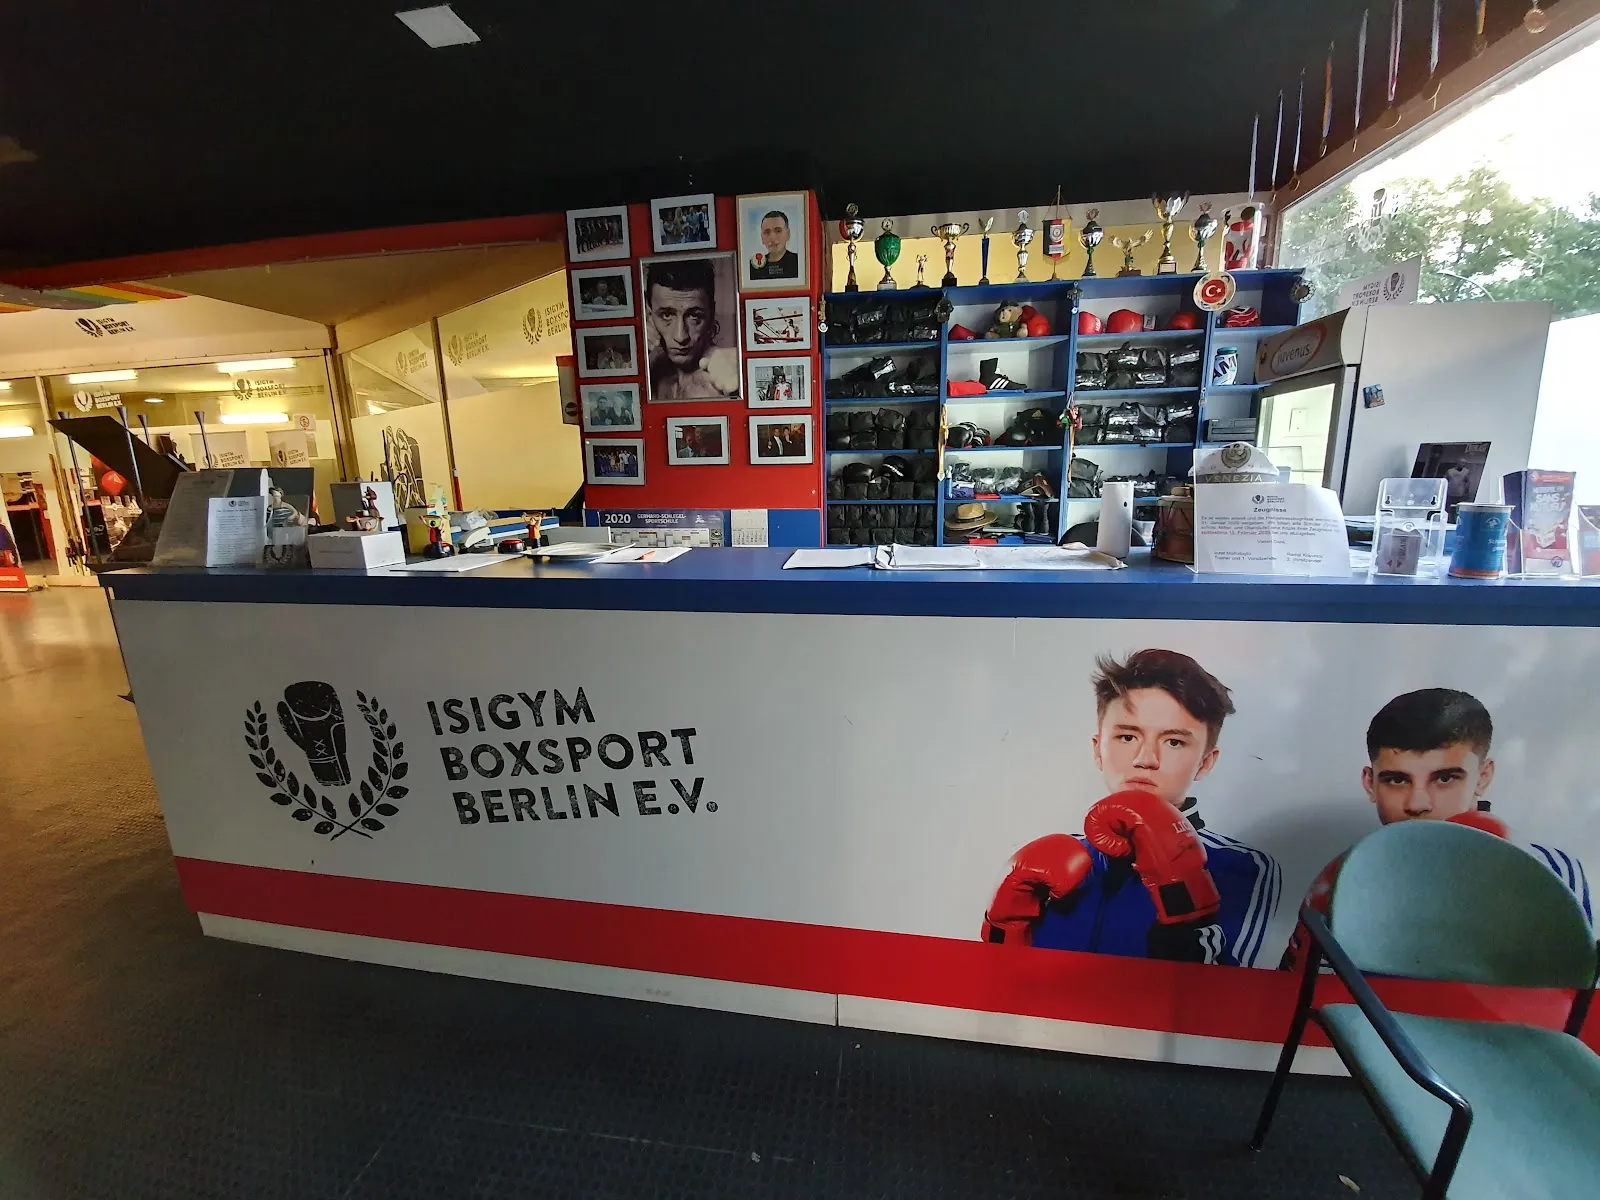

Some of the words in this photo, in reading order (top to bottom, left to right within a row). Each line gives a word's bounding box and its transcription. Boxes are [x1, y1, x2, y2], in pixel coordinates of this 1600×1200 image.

[545, 301, 564, 316] ISIGYM
[546, 309, 569, 327] BOXSPO
[548, 322, 567, 336] BERLIN
[1205, 474, 1263, 483] VENEZIA
[605, 513, 631, 524] 2020
[427, 687, 595, 735] ISIGYM
[440, 728, 696, 780] BOXSPORT
[453, 783, 620, 825] BERLIN
[633, 777, 718, 815] E.V.
